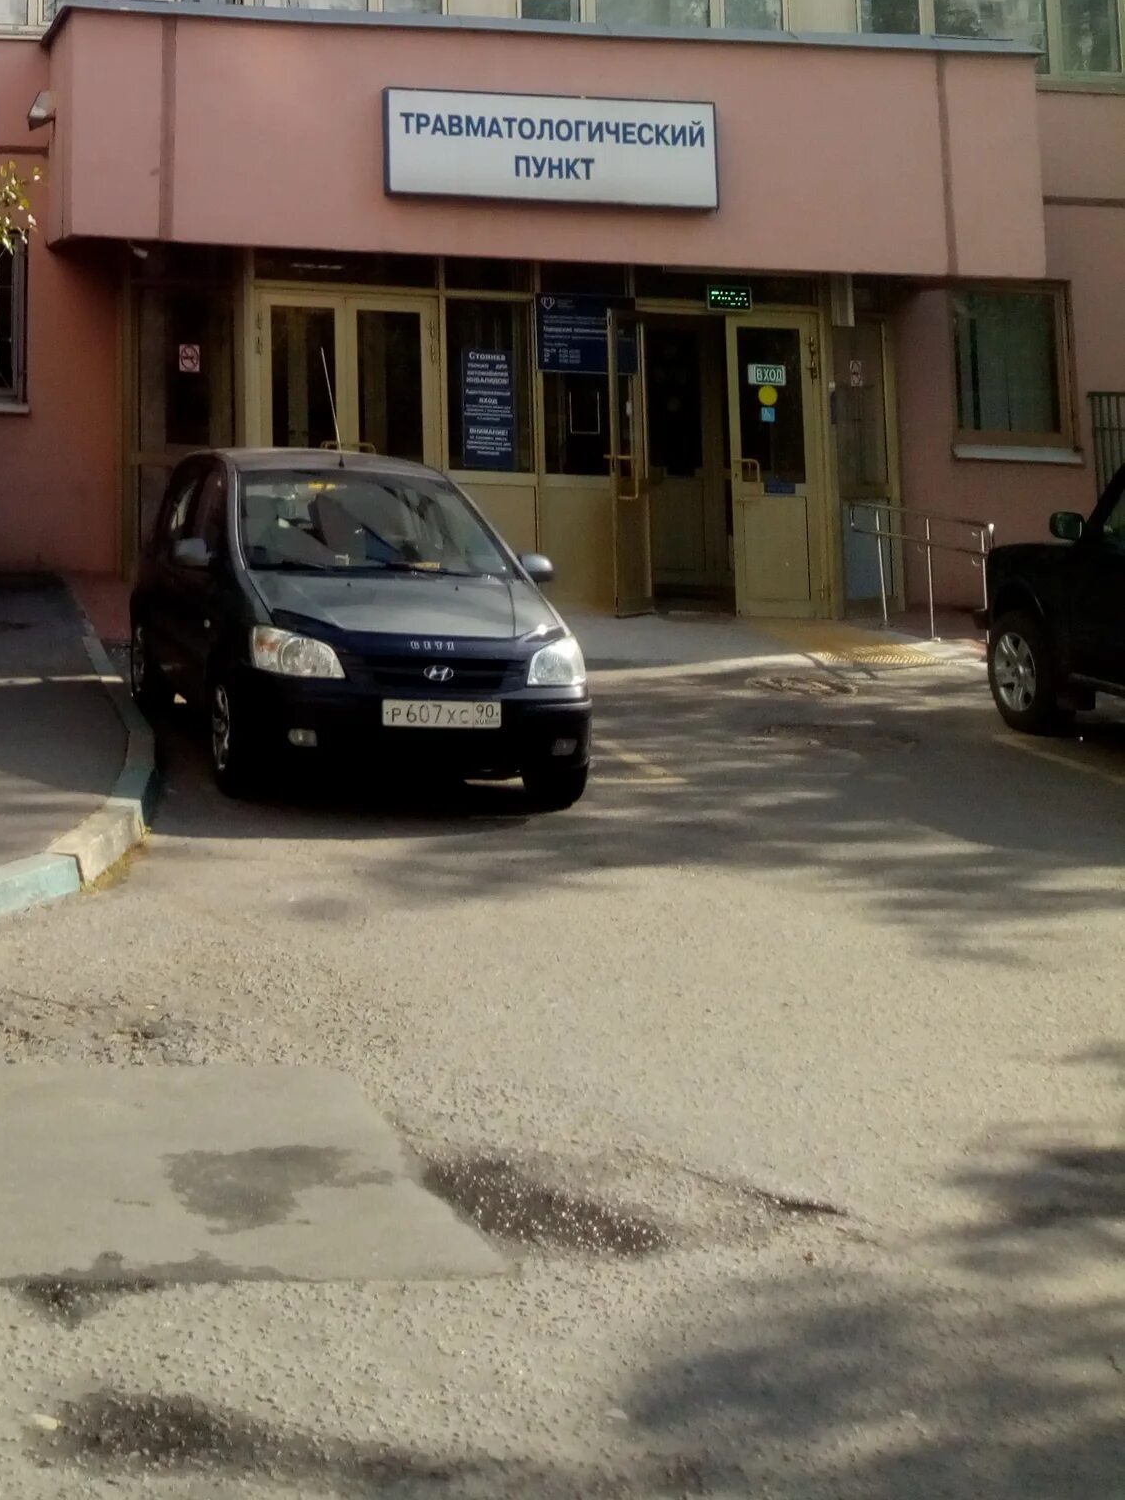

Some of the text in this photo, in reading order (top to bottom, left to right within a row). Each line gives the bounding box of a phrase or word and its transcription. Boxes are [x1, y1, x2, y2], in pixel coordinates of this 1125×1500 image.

[399, 112, 706, 148] ТРАВМАТОЛОГИЧЕСКИЙ
[514, 155, 596, 180] ПУНКТ
[756, 365, 784, 383] ВХОД
